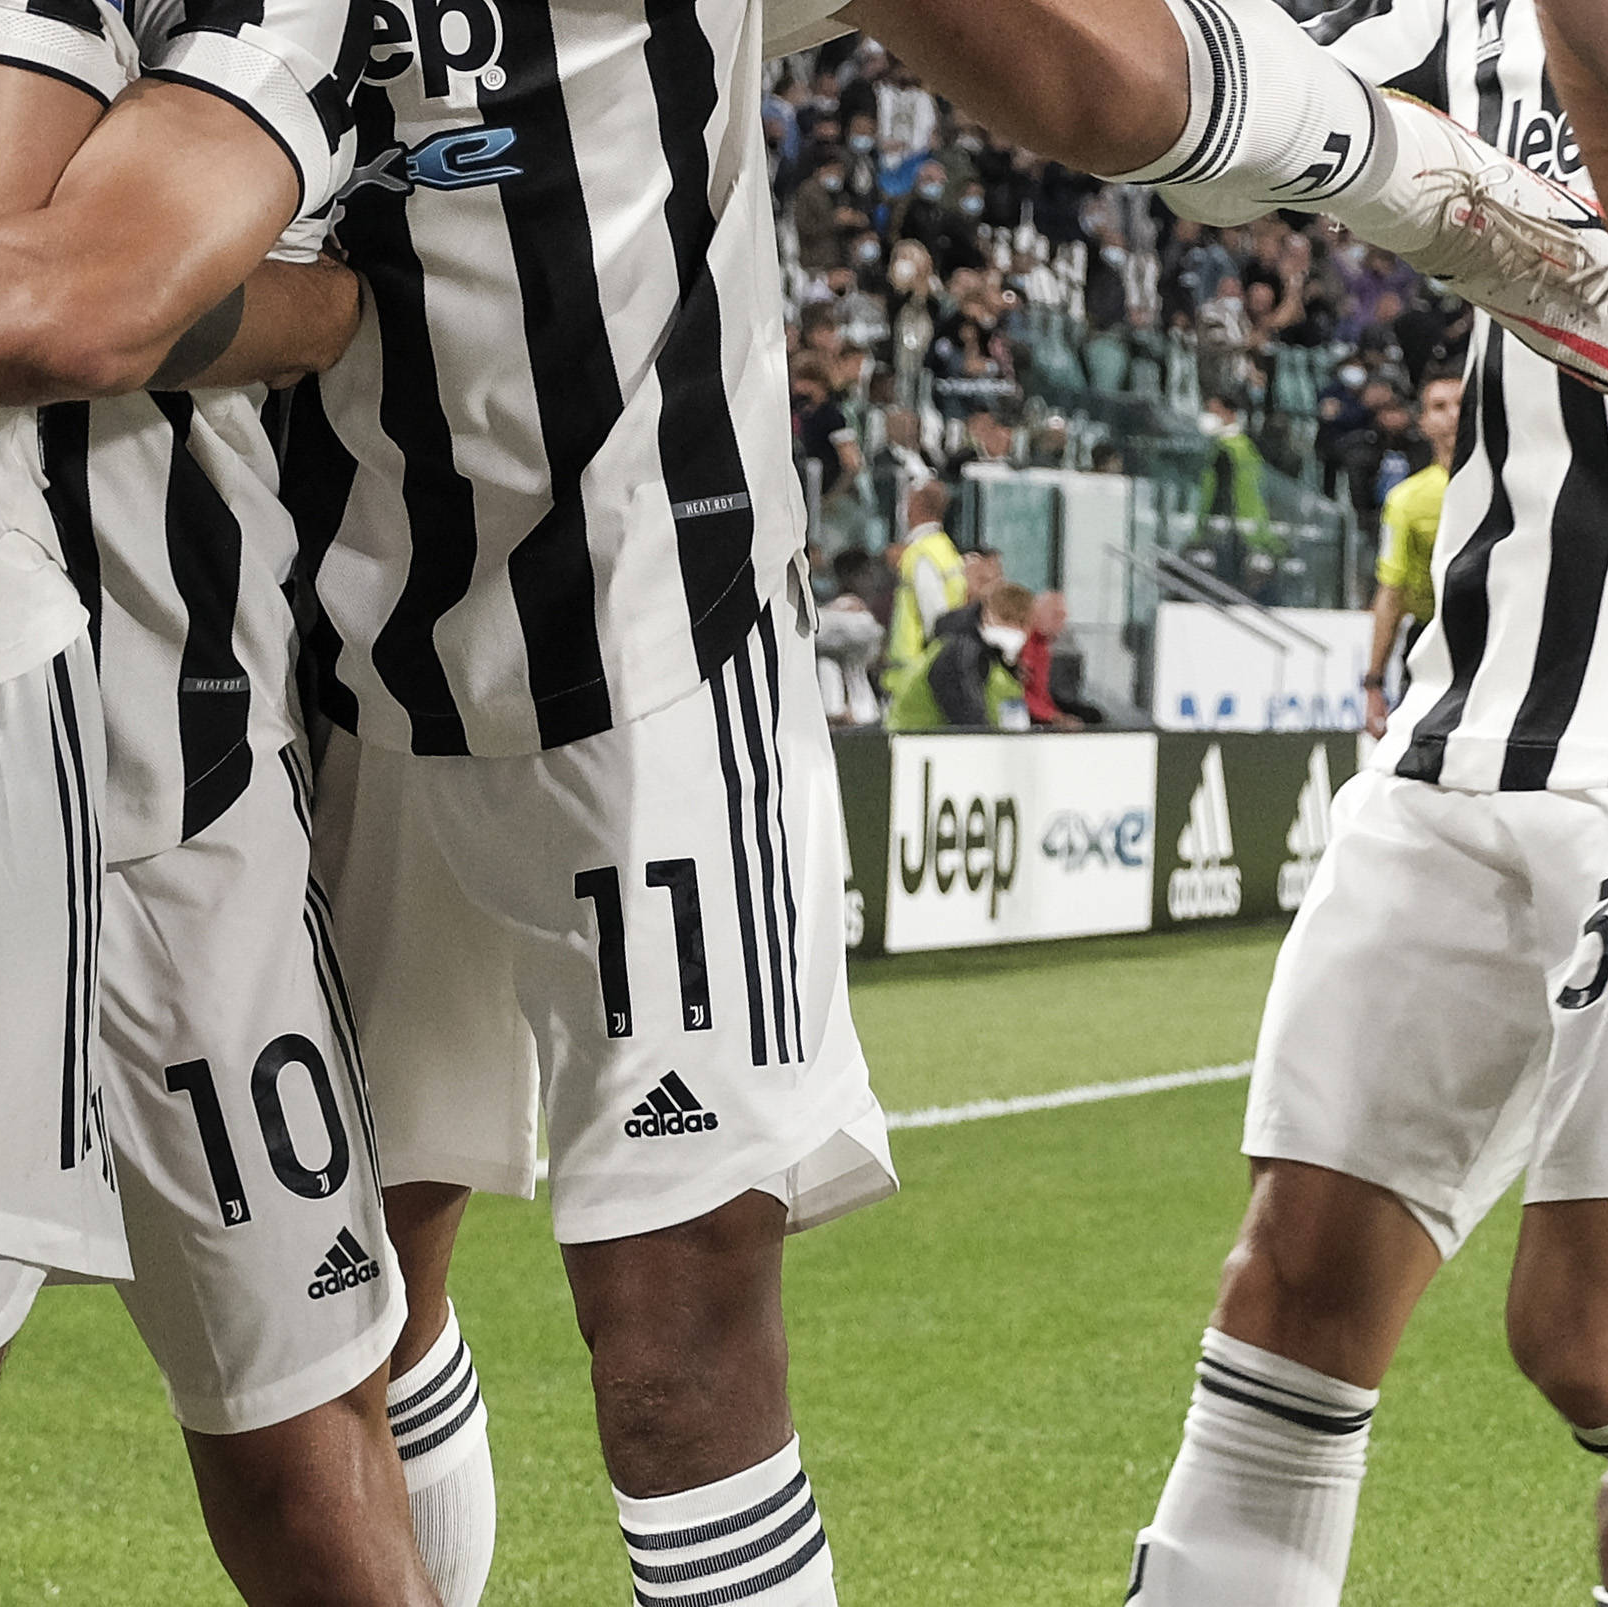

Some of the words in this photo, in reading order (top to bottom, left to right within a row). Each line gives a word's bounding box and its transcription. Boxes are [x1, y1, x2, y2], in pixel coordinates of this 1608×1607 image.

[900, 757, 1019, 920] Jeep
[574, 857, 713, 1039] 11
[164, 1033, 351, 1229] 10
[623, 1110, 720, 1139] adidas
[306, 1259, 381, 1301] adidas
